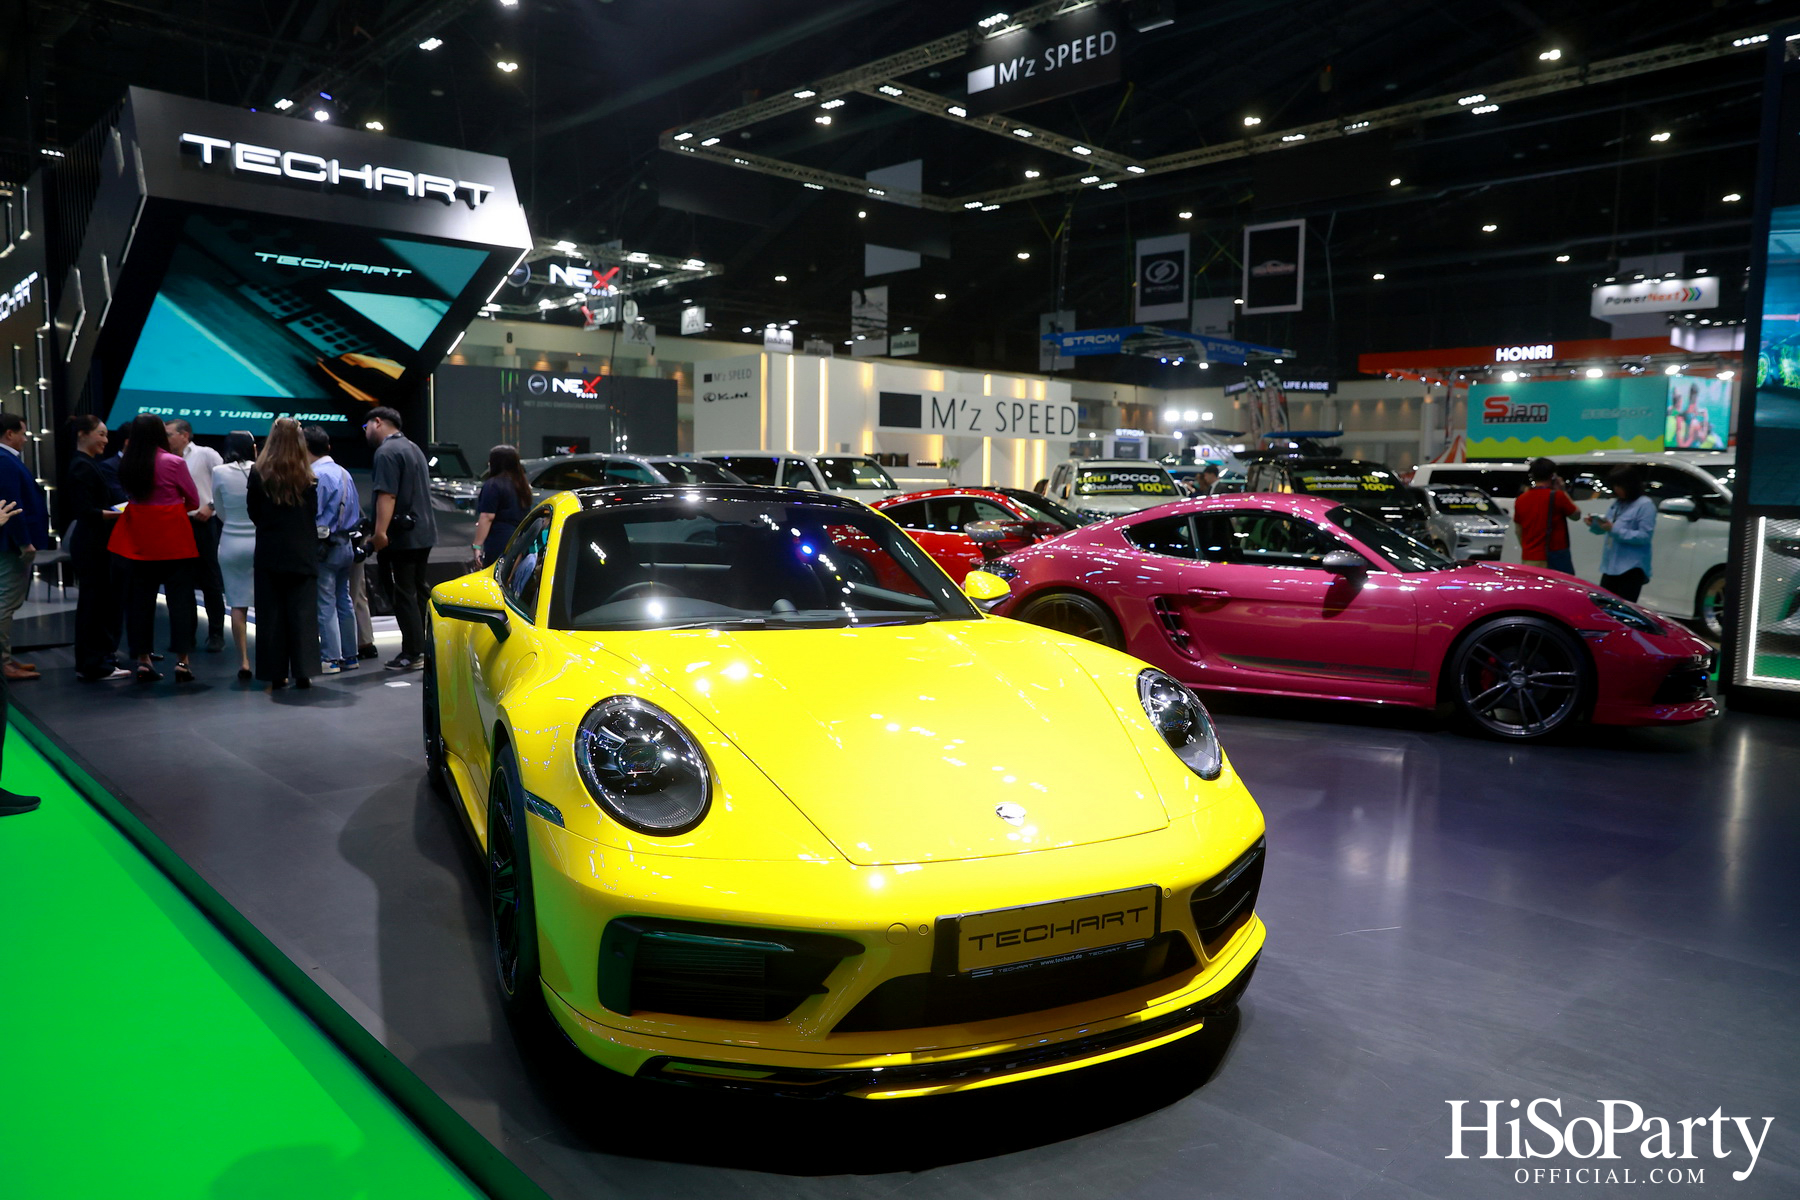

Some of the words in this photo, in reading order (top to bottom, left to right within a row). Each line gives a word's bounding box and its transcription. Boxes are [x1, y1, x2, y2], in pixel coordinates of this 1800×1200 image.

[999, 56, 1035, 84] M'z
[1044, 30, 1117, 71] SPEED
[180, 132, 495, 207] TECHART
[255, 252, 412, 277] TECHART
[550, 264, 620, 290] NEX
[1062, 334, 1120, 347] STROM
[1495, 344, 1554, 362] HONRI
[552, 376, 602, 394] NEX
[1282, 381, 1301, 389] LIFE
[1308, 382, 1329, 390] RIDE
[138, 407, 174, 415] FOR
[179, 409, 212, 417] 911
[219, 410, 274, 419] TURBO
[294, 412, 349, 422] MODEL
[932, 396, 982, 432] M'z
[995, 401, 1076, 436] SPEED
[1484, 396, 1549, 418] Siam
[969, 906, 1149, 951] TECHART
